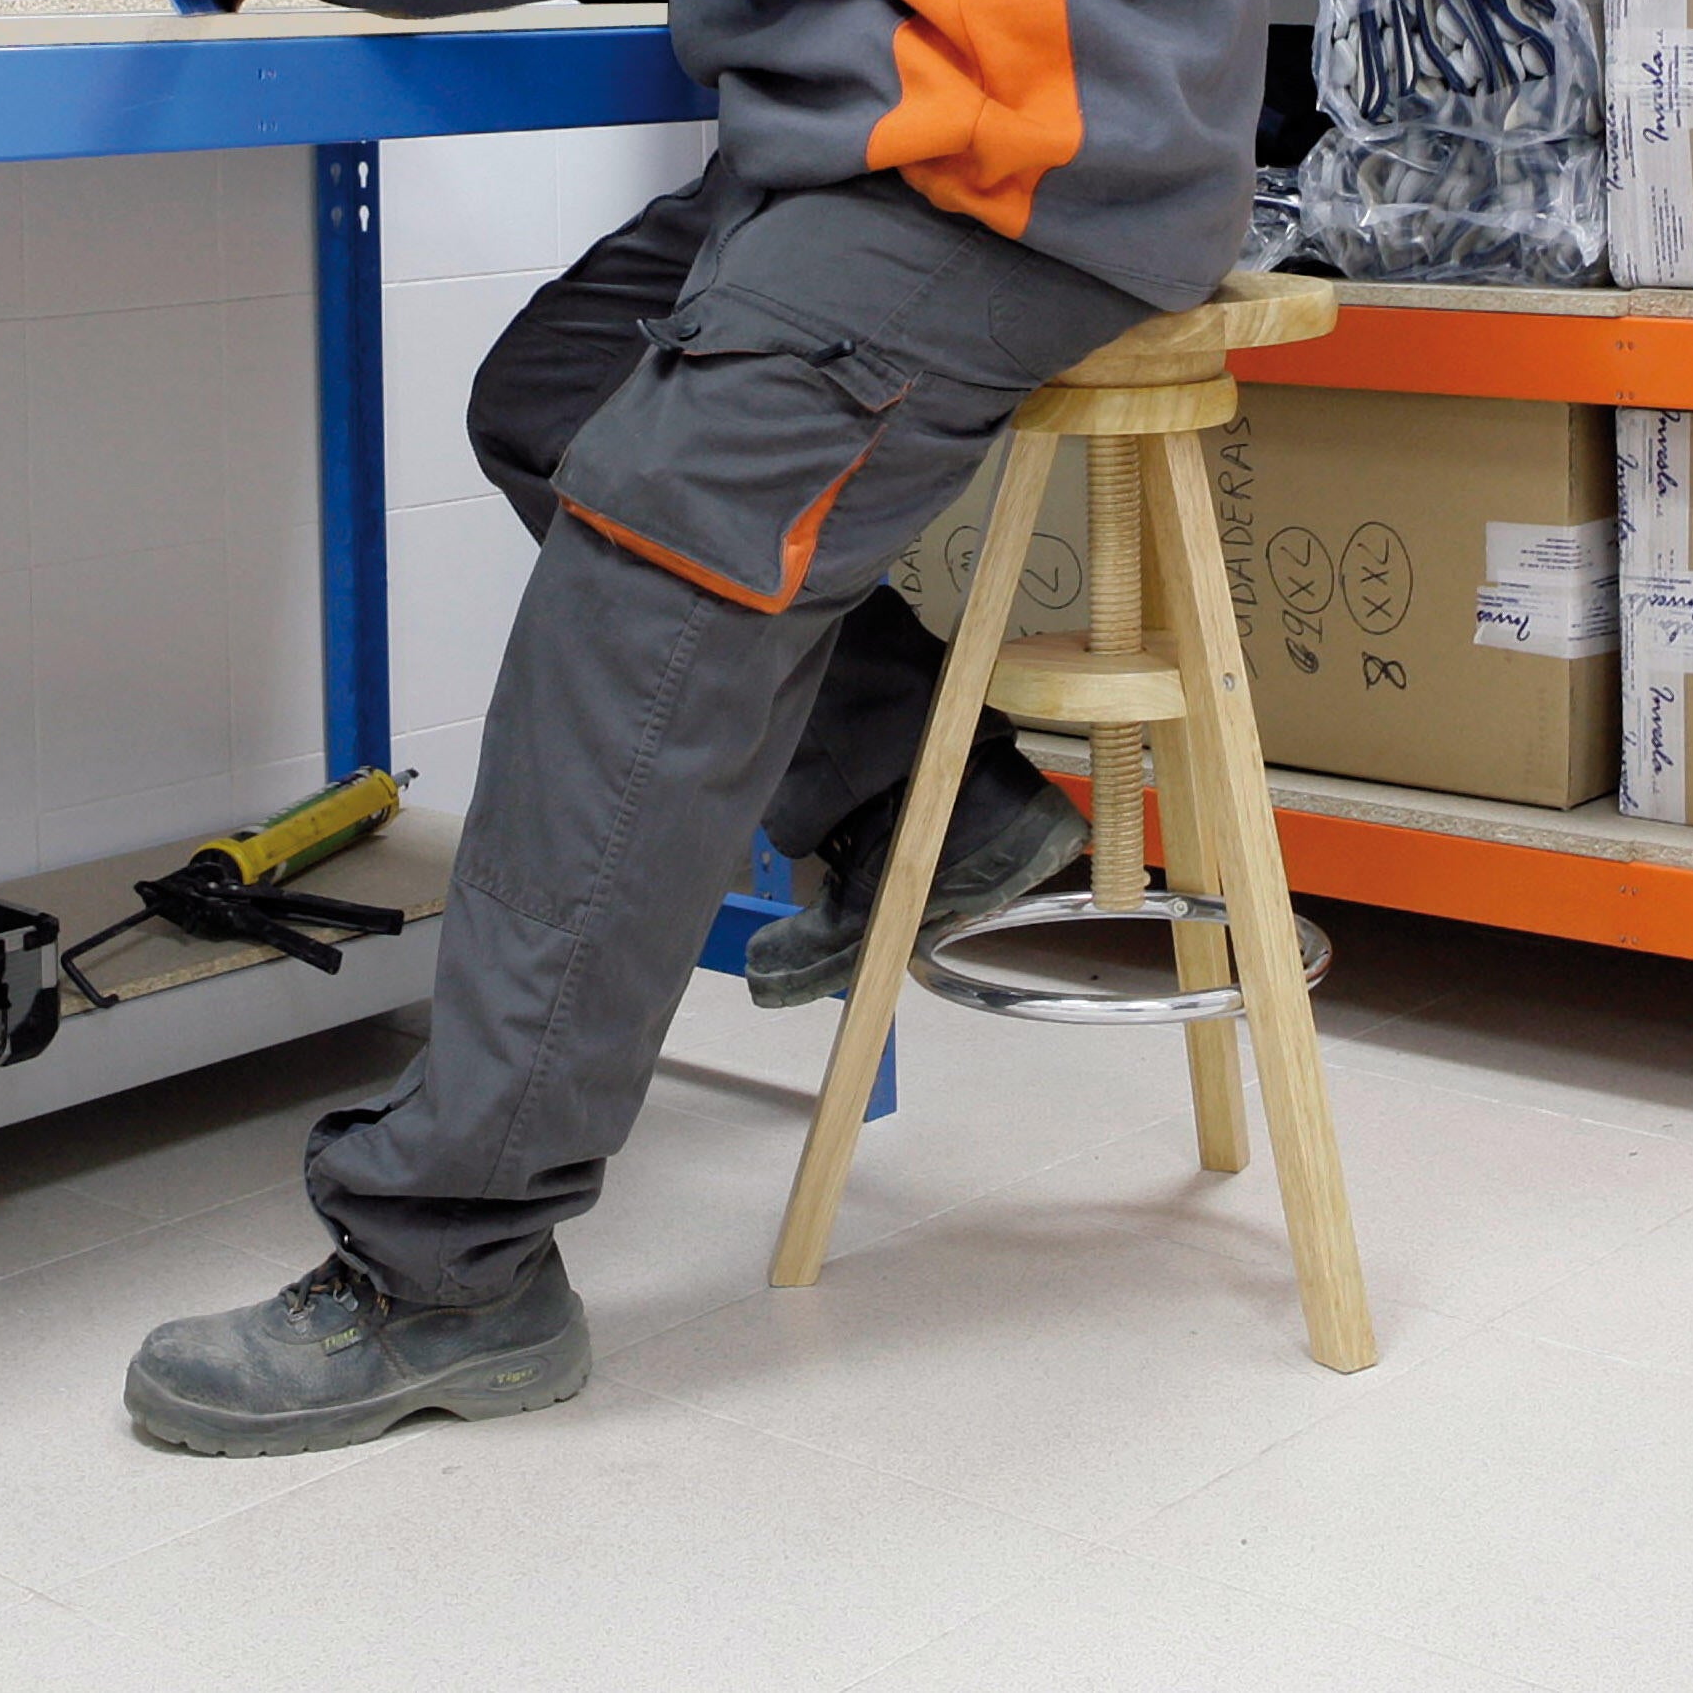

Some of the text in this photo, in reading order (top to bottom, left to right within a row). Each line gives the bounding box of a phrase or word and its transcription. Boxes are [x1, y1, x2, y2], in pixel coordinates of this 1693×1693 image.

[1642, 50, 1669, 143] Invesla
[1281, 539, 1315, 599] XL
[1358, 539, 1393, 618] XXL
[1649, 685, 1675, 775] Invesla
